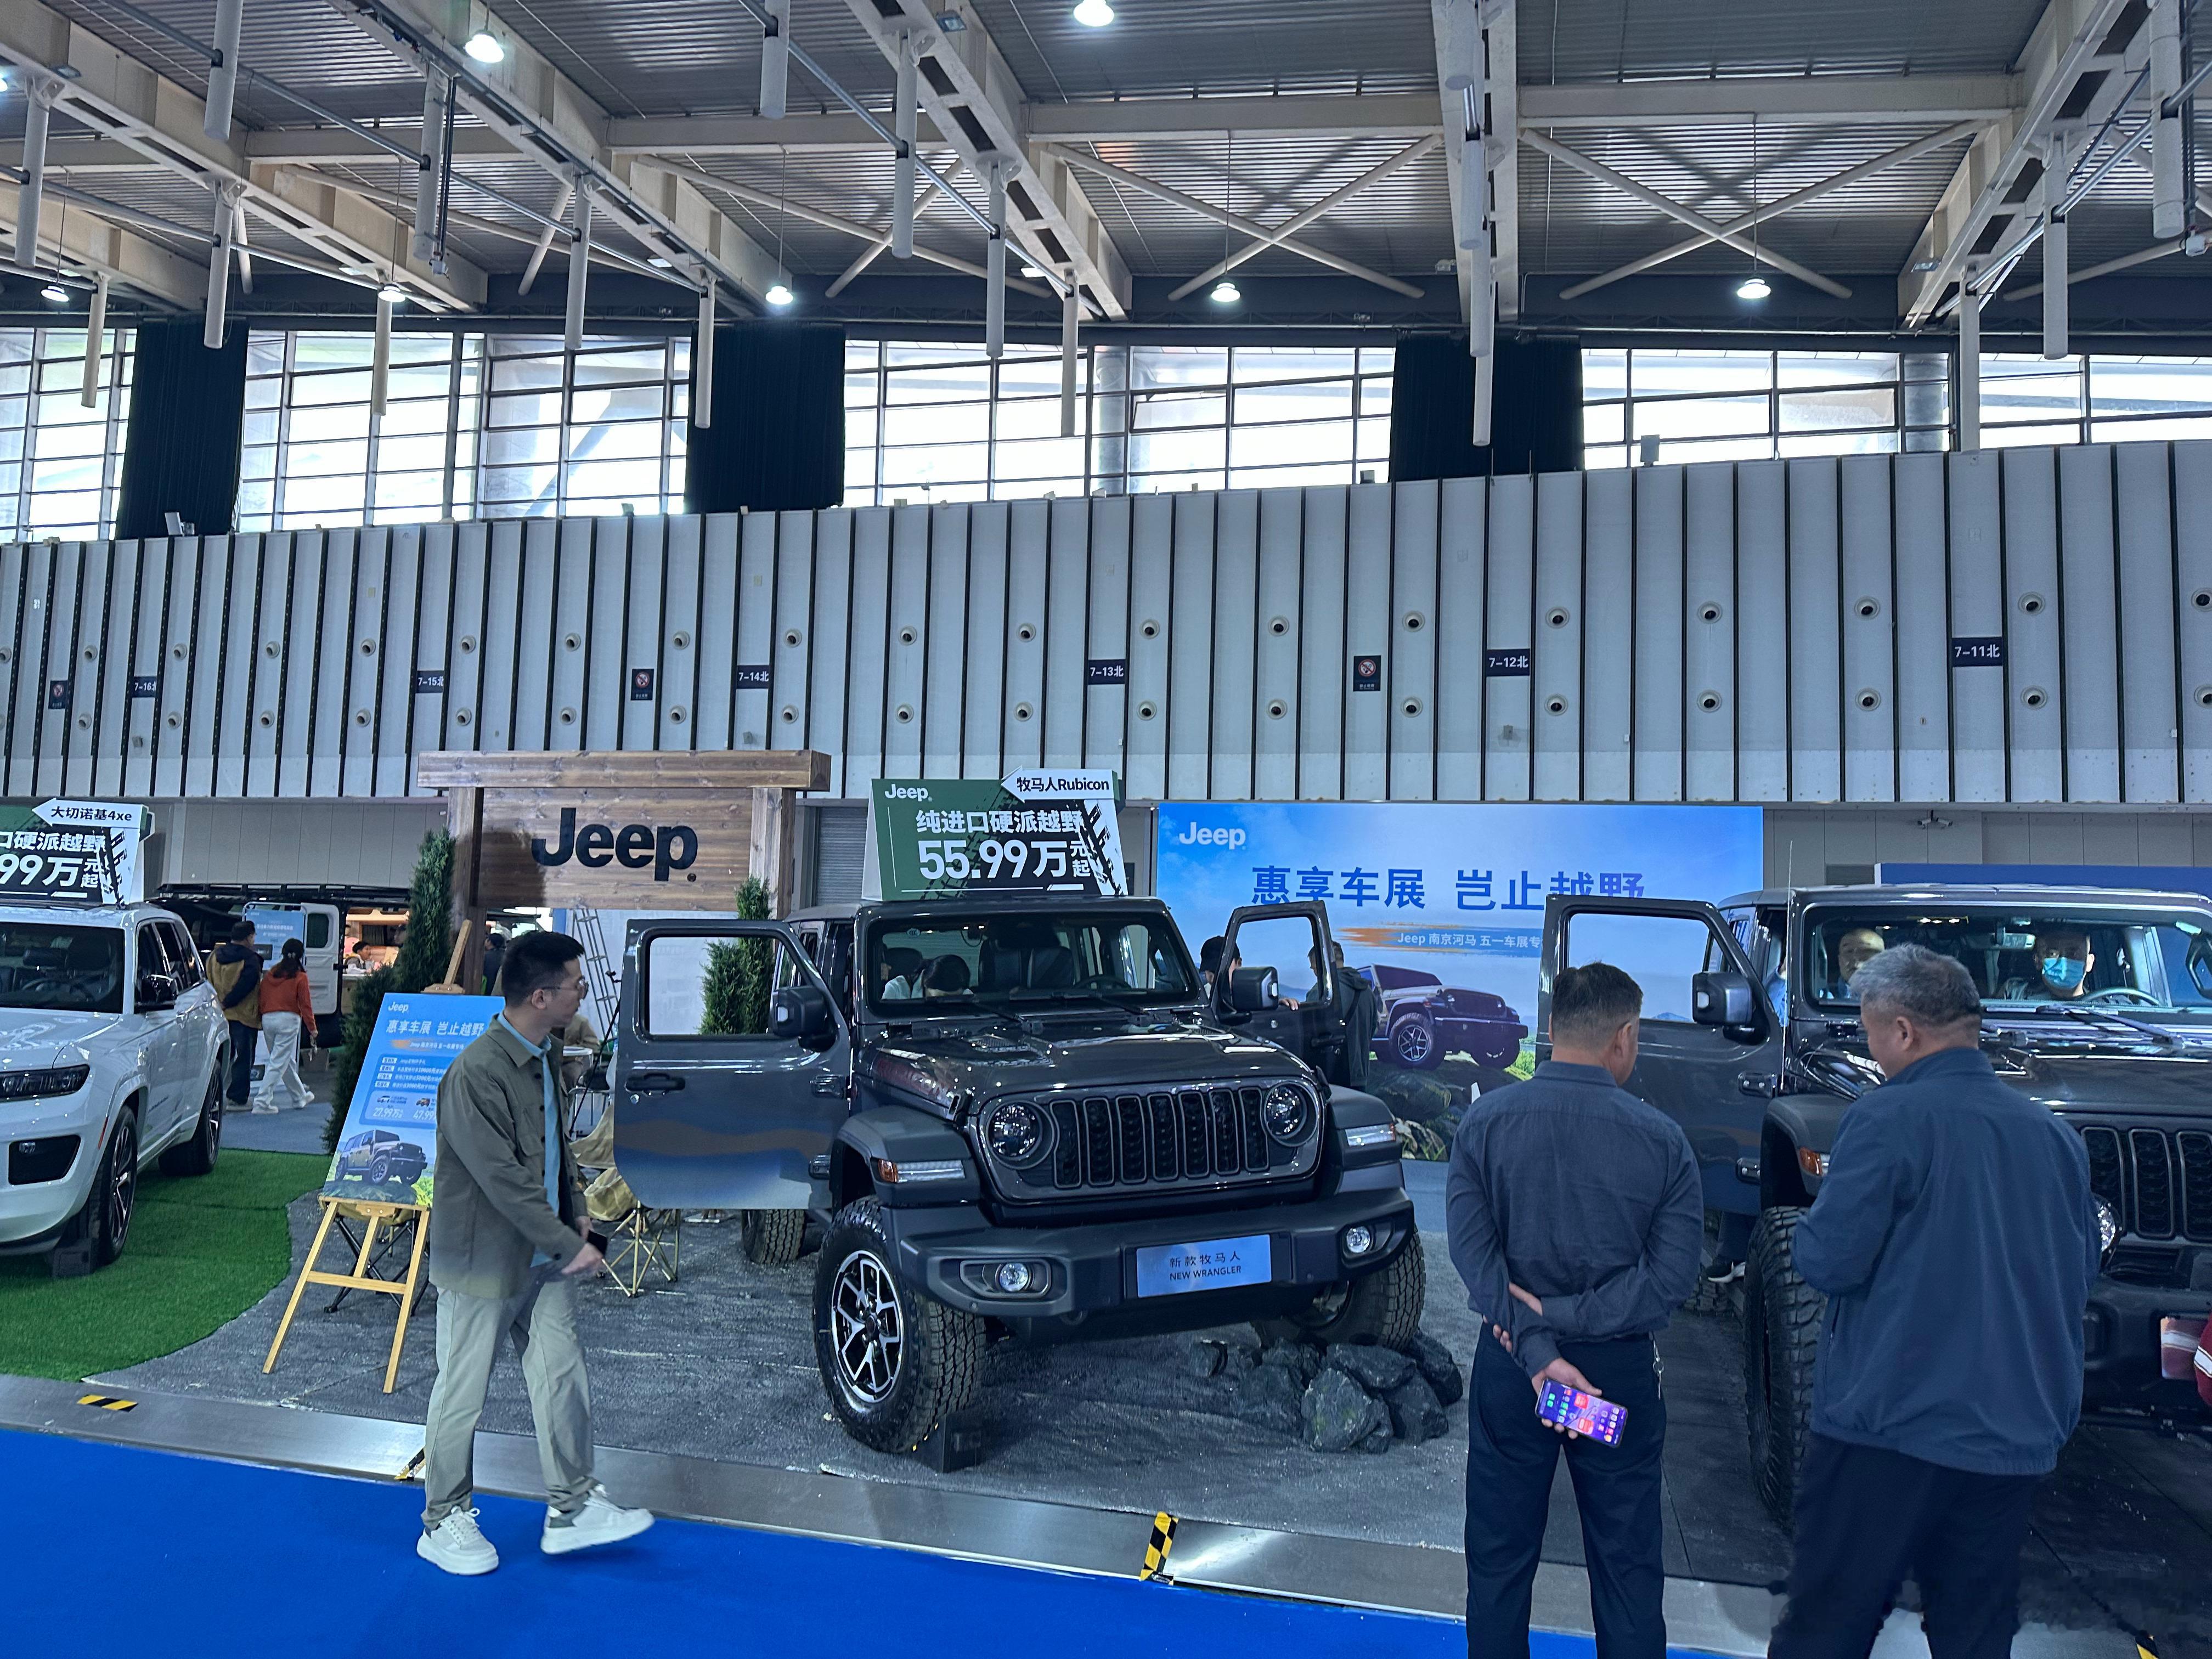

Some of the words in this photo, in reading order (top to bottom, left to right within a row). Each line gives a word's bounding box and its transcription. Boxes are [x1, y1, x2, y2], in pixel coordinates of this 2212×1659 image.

[1954, 644, 2000, 658] 7-11北
[1489, 656, 1528, 668] 7-12北
[738, 671, 769, 682] 7-14北
[1090, 665, 1124, 677] 7-13北
[1017, 777, 1109, 792] 牧马人Rubicon
[884, 783, 928, 802] Jeep
[51, 806, 132, 821] 大切诺基4xe
[916, 809, 1084, 833] 纯进口硬派越野
[1180, 822, 1246, 850] Jeep
[531, 808, 698, 881] Jeep
[1251, 865, 1425, 909] 惠享车展
[1398, 933, 1426, 946] Jeep
[1429, 933, 1476, 946] 南京河马
[388, 1002, 409, 1013] Jeep
[386, 1020, 432, 1034] 惠享车展
[436, 1022, 484, 1036] 岂止越野
[1170, 1271, 1190, 1281] NEW
[1193, 1265, 1242, 1278] WRANGLER
